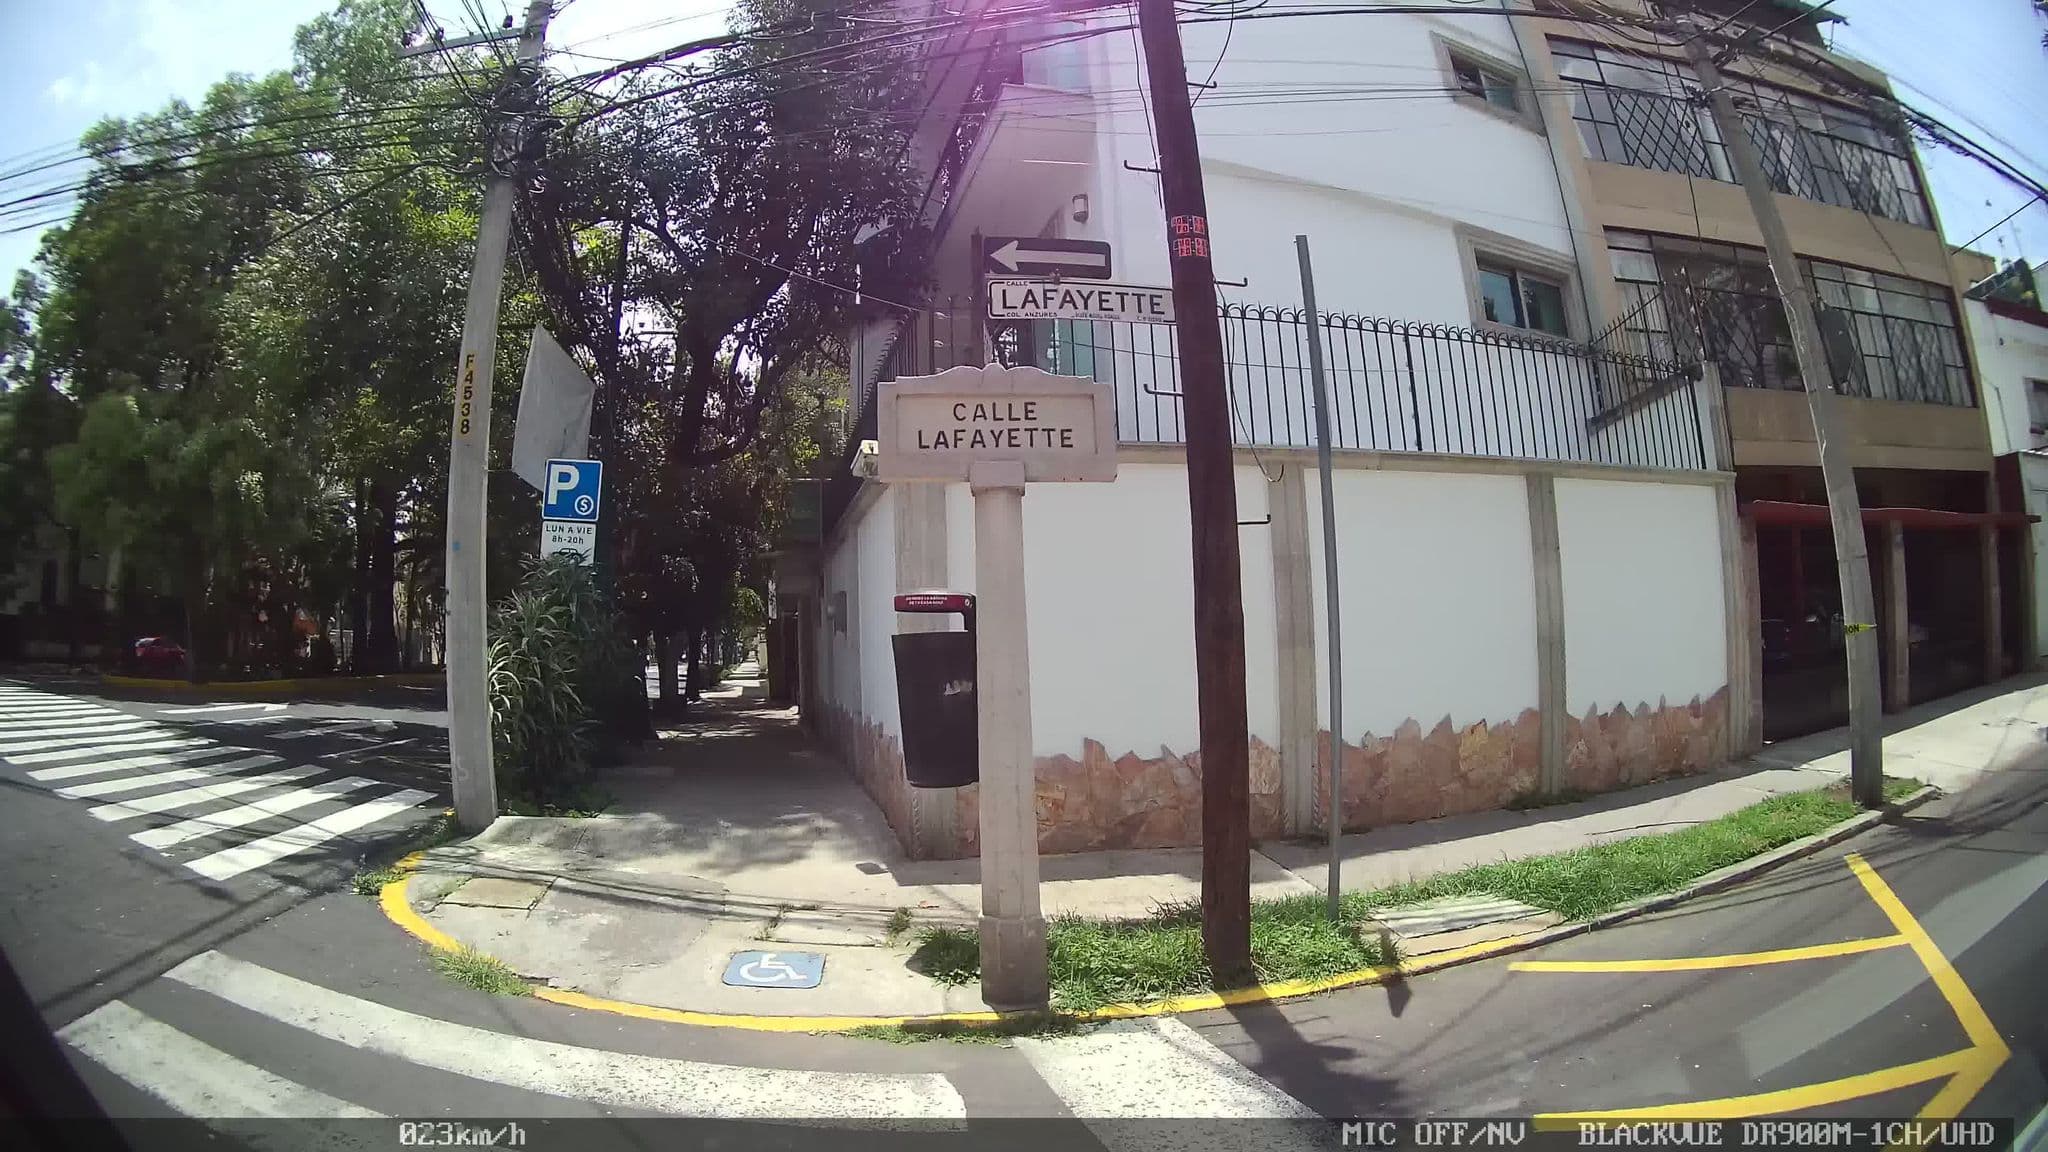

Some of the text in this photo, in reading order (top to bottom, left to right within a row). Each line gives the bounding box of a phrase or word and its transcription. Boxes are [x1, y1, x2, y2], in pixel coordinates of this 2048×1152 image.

[1002, 288, 1165, 315] LAFAYETTE
[460, 354, 475, 435] F4538
[953, 402, 1037, 422] CALLE
[918, 427, 1073, 450] LAFAYETTE
[547, 464, 580, 505] P
[545, 524, 593, 535] LUN A VIE
[551, 536, 584, 545] 8h-20h
